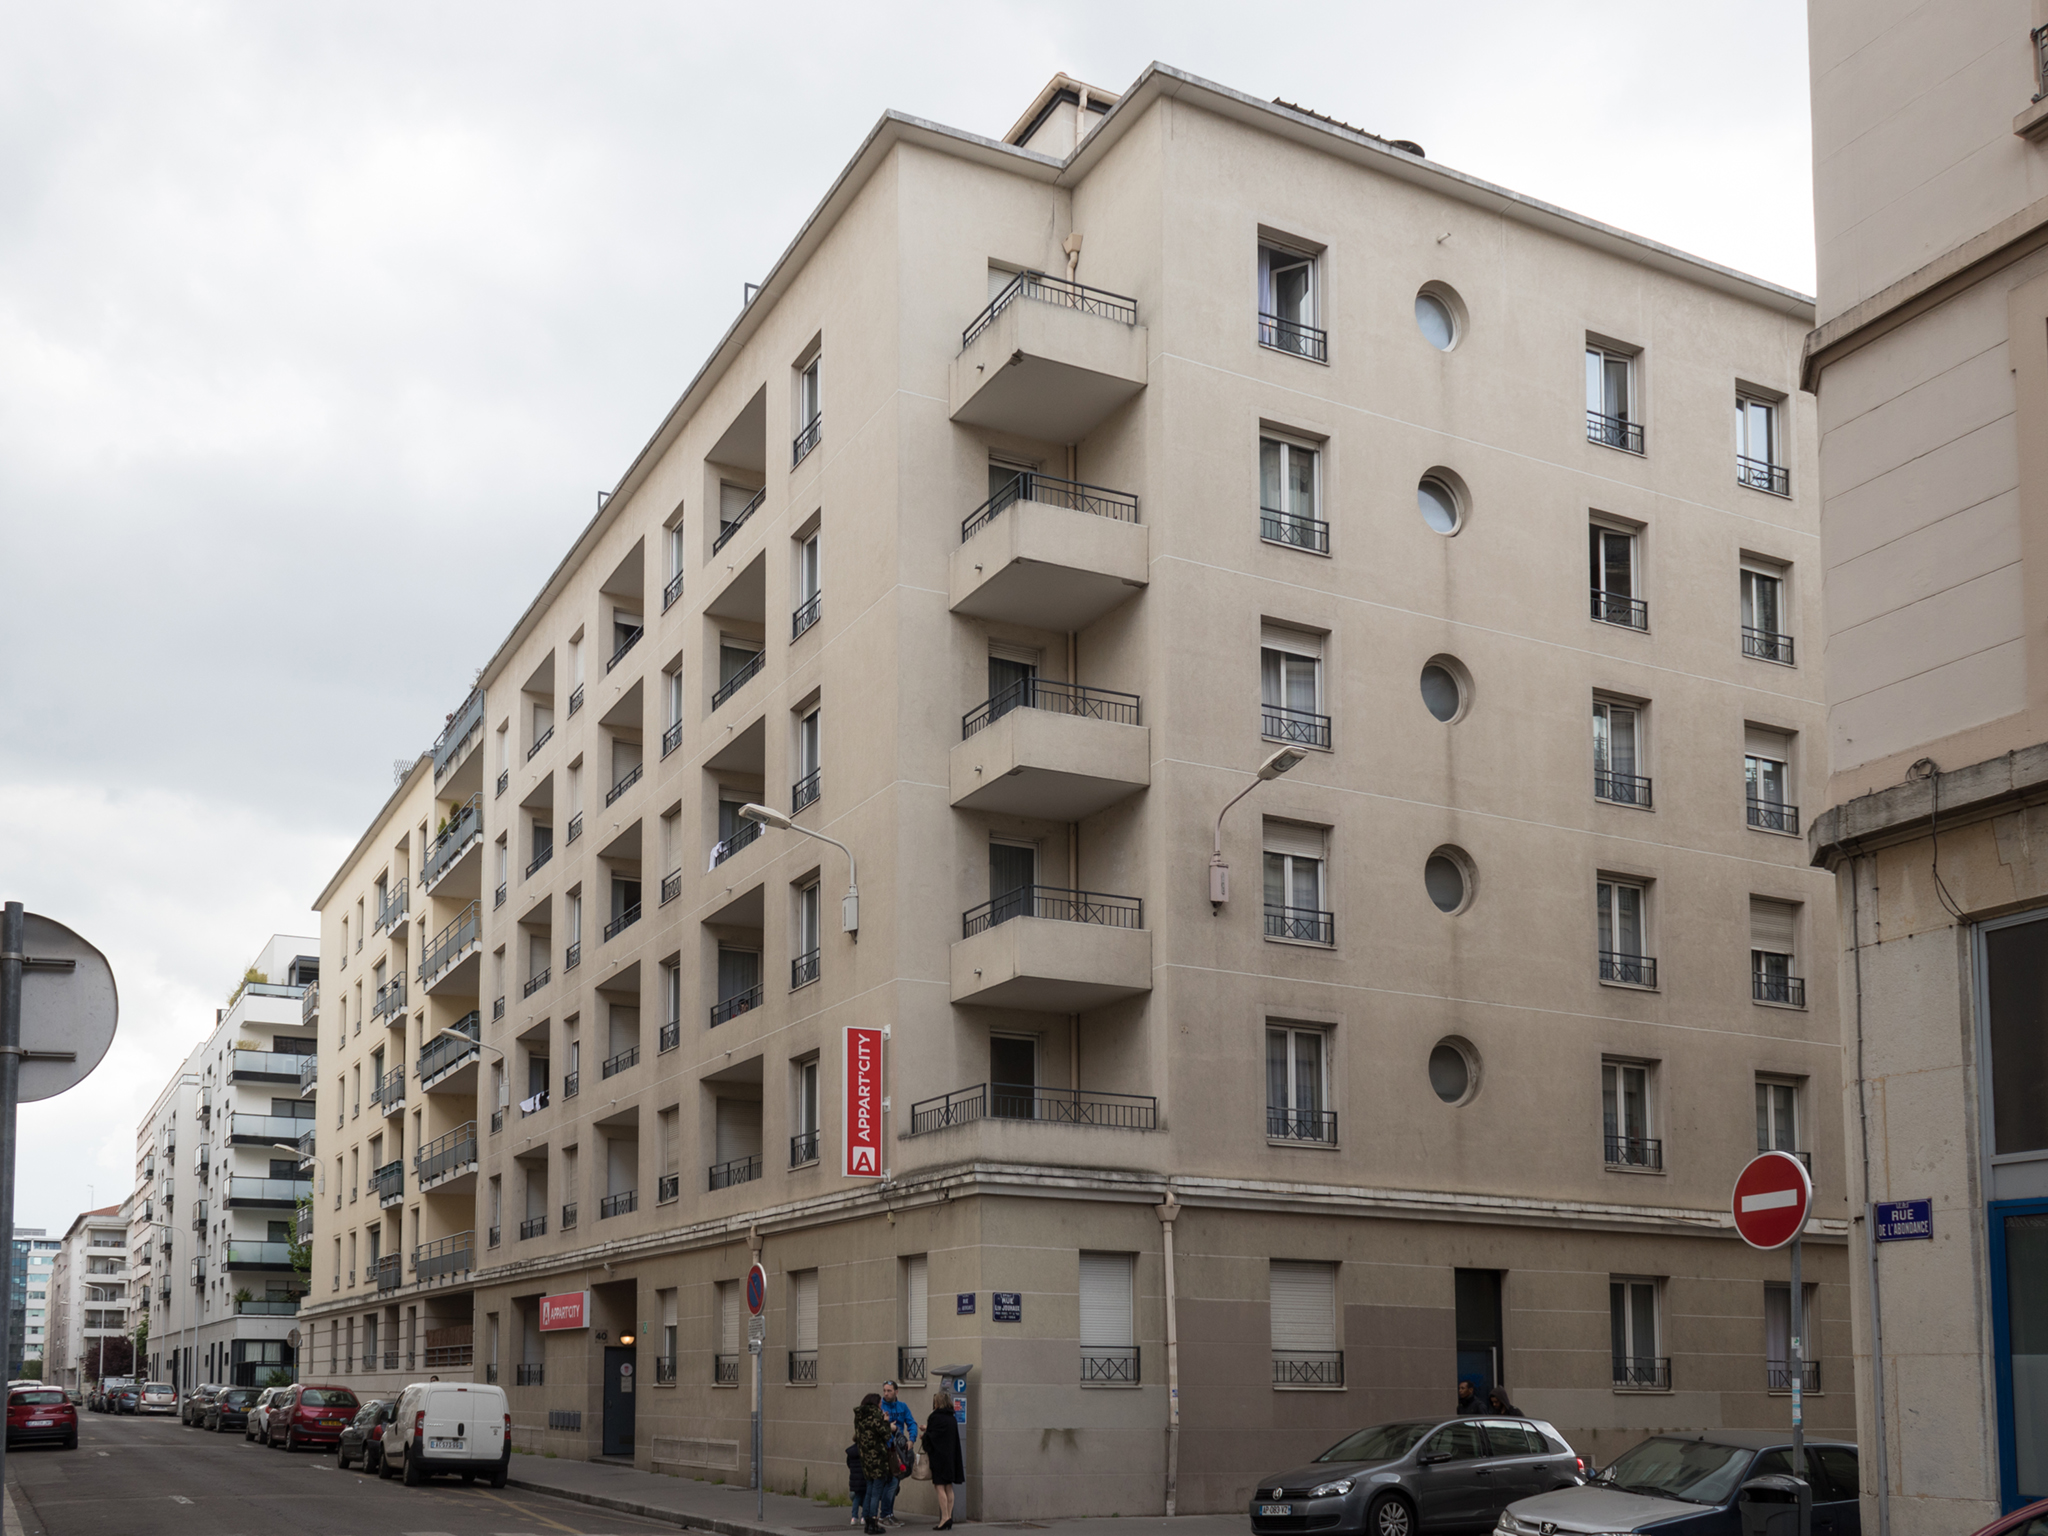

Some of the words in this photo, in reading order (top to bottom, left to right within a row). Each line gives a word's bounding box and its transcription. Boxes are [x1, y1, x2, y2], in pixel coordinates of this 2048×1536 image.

[858, 1033, 871, 1142] APPART'CITY
[1891, 1209, 1914, 1221] RUE
[1878, 1224, 1887, 1236] DE
[1887, 1220, 1929, 1236] L'ABONDANCE
[551, 1305, 580, 1319] APPART'CITY
[596, 1332, 607, 1340] 40
[957, 1379, 965, 1392] P
